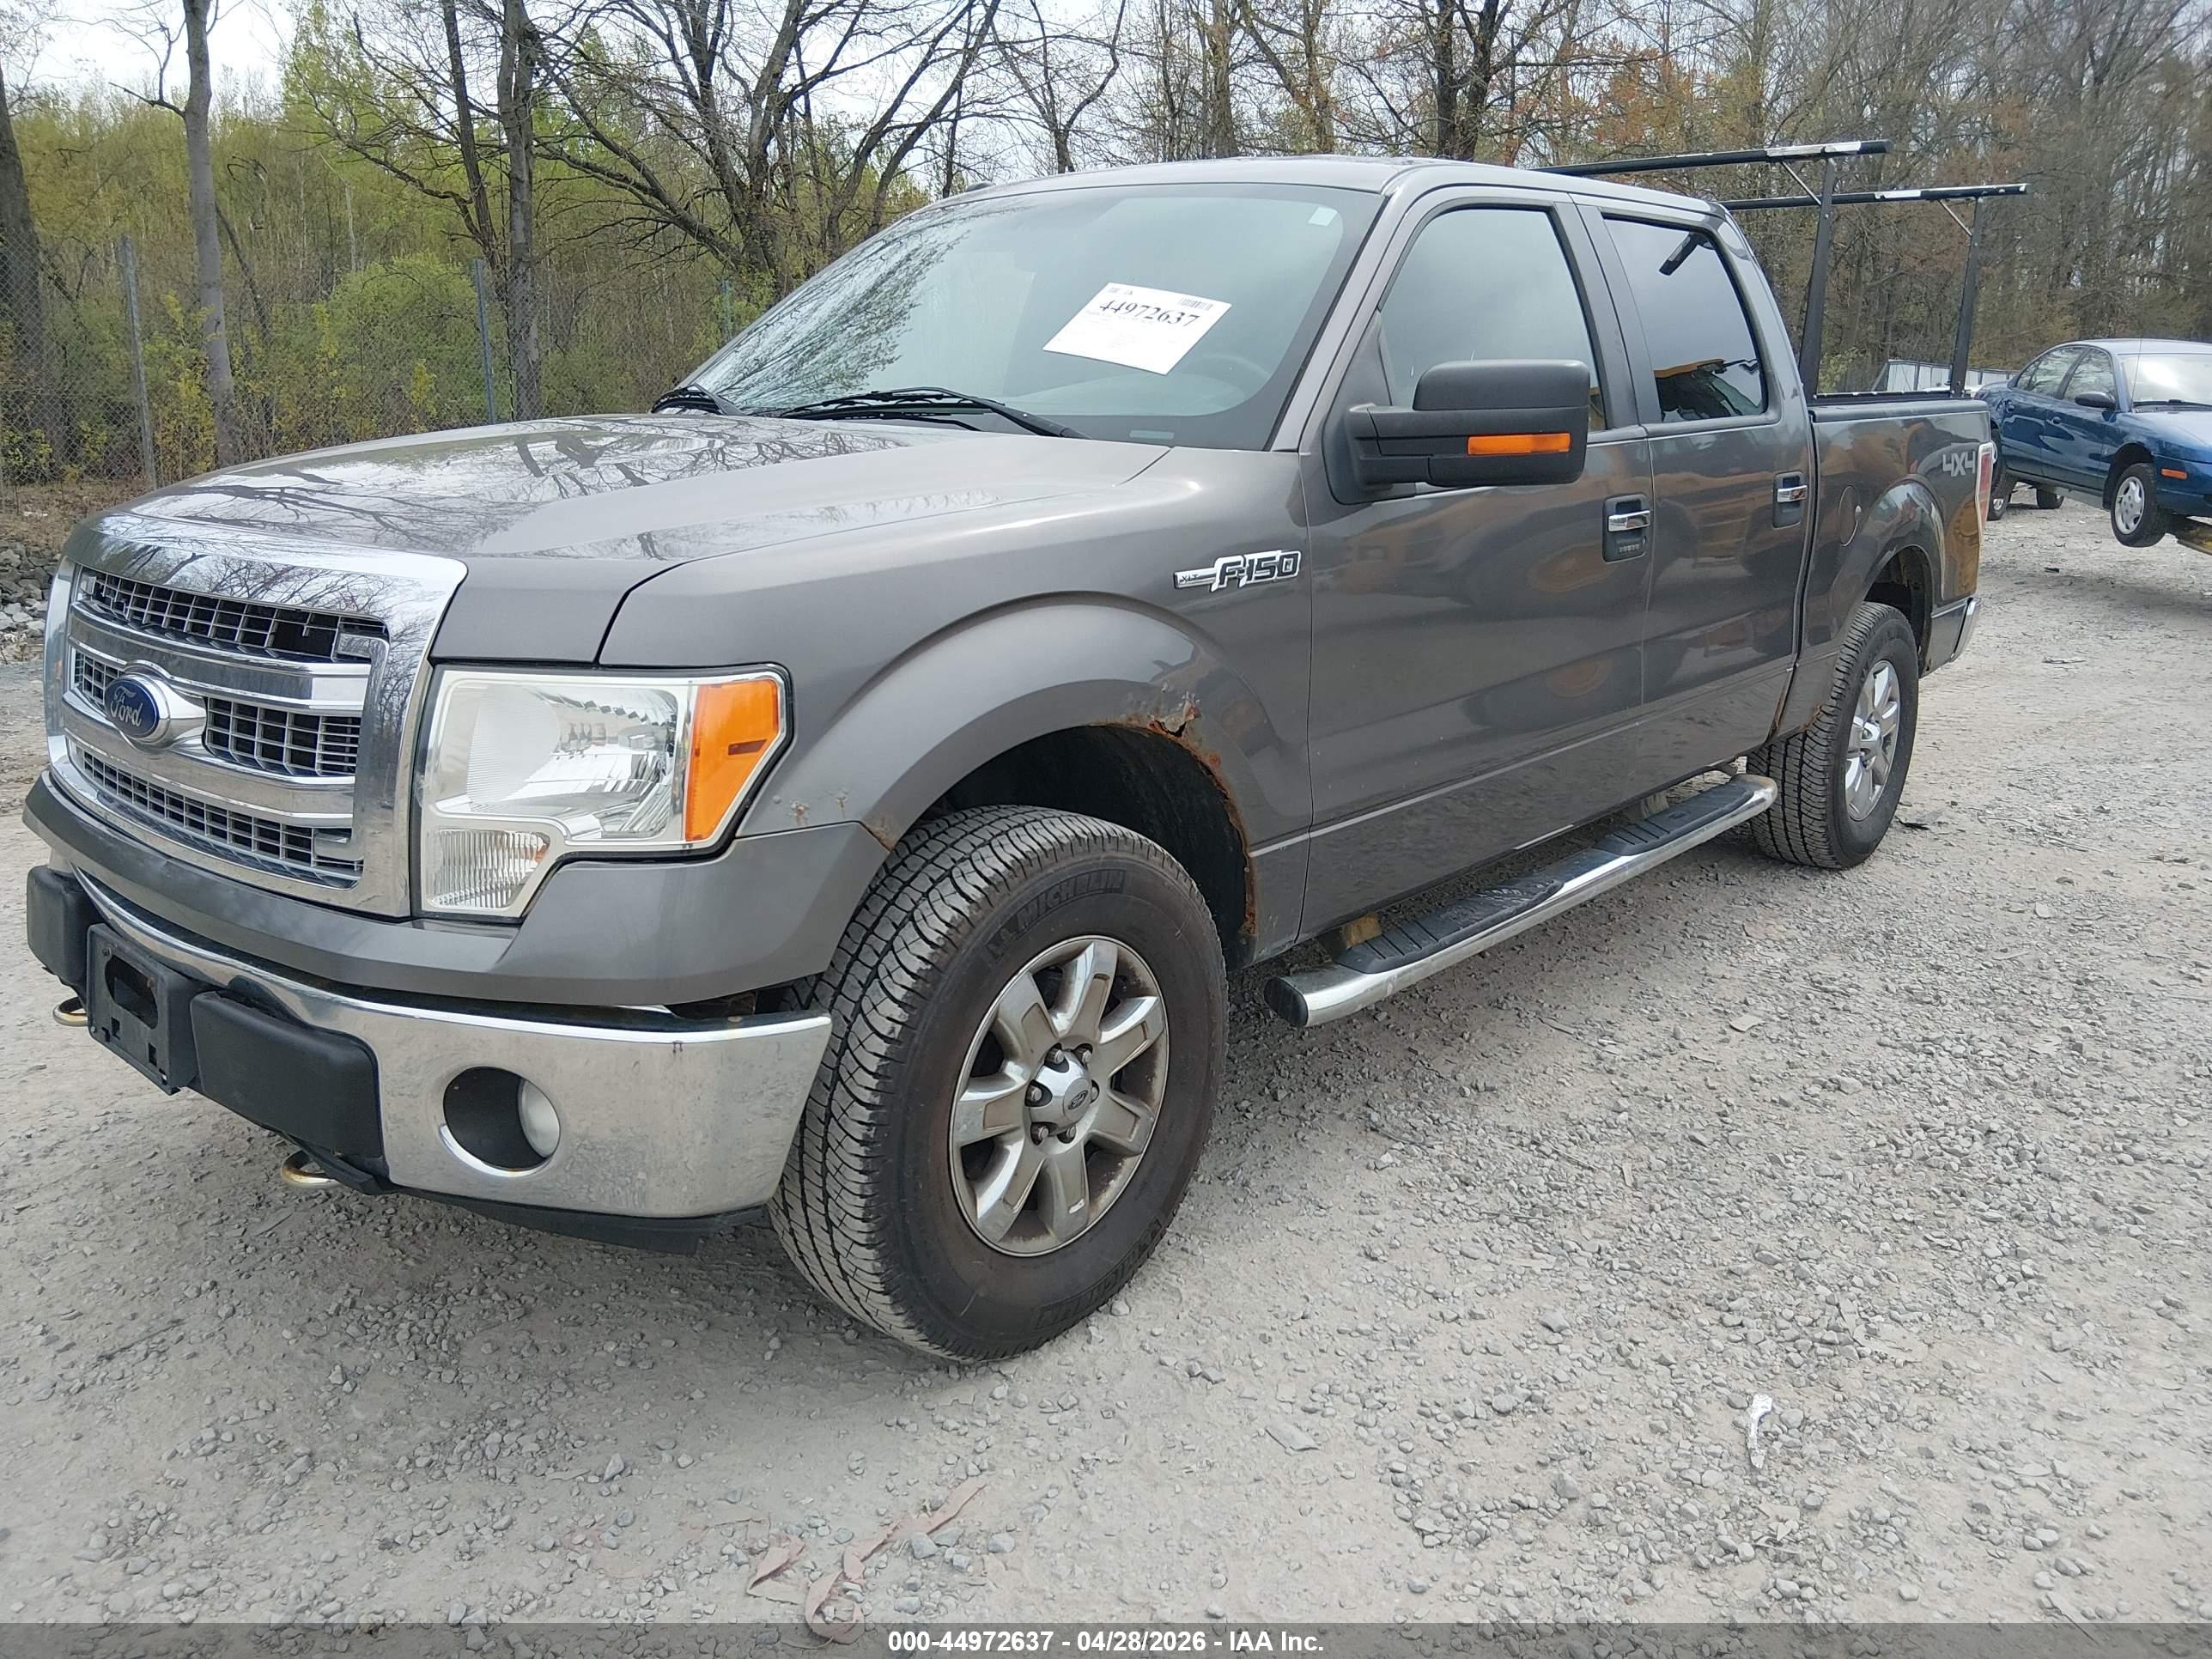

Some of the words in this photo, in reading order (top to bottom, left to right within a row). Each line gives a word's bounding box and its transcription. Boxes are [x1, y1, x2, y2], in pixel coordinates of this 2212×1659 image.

[1099, 300, 1200, 327] 44972637
[110, 685, 143, 727] Ford
[1015, 868, 1127, 934] MICHELIN
